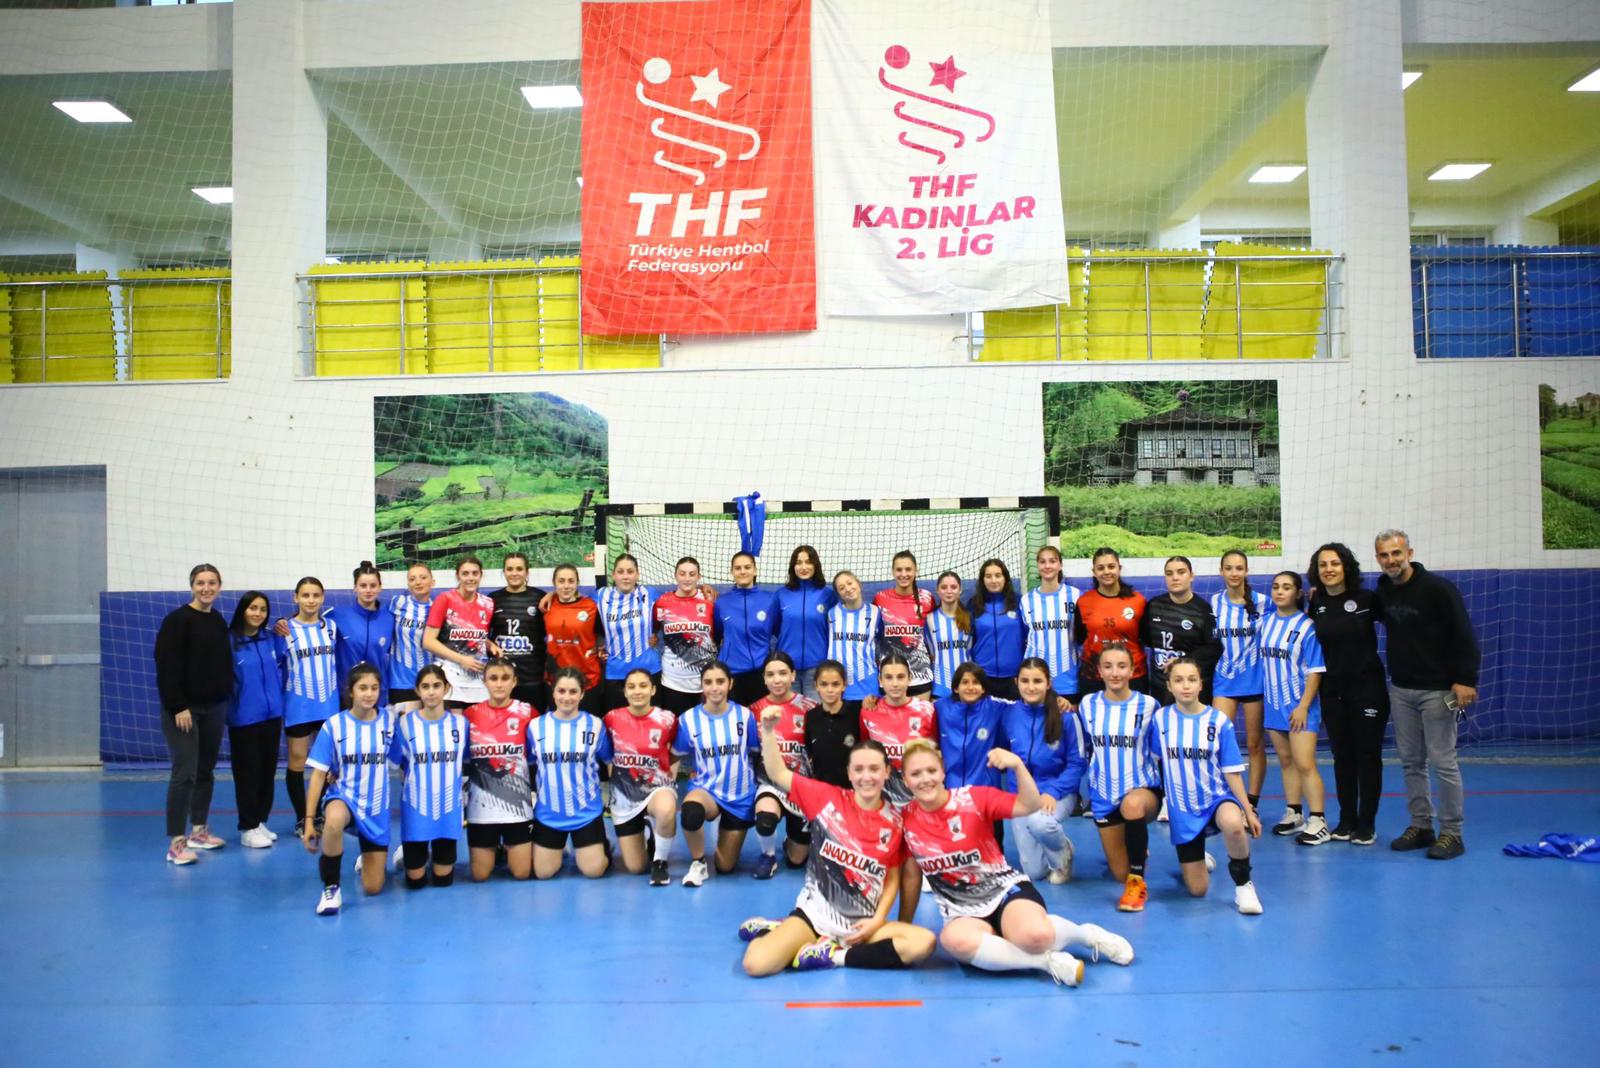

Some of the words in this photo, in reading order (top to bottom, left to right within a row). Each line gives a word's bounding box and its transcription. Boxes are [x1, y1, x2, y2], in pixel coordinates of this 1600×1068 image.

[908, 173, 978, 199] THF
[628, 187, 768, 238] THF
[852, 195, 1036, 229] KADINLAR
[628, 243, 693, 259] Türkiye
[698, 239, 770, 257] Hentbol
[896, 237, 926, 260] 2.
[937, 227, 995, 259] LİG
[627, 259, 744, 276] Federasyonu
[1064, 602, 1076, 614] 18
[506, 619, 520, 635] 12
[865, 617, 871, 629] 7
[1104, 618, 1116, 628] 35
[496, 636, 530, 651] TEOL
[1161, 631, 1174, 649] 12
[1286, 630, 1300, 644] 17
[736, 722, 744, 736] 6
[1134, 714, 1143, 729] 11
[452, 729, 460, 743] 9
[582, 731, 595, 746] 10
[1207, 726, 1216, 742] 8
[822, 843, 886, 878] ANADOLUKurs
